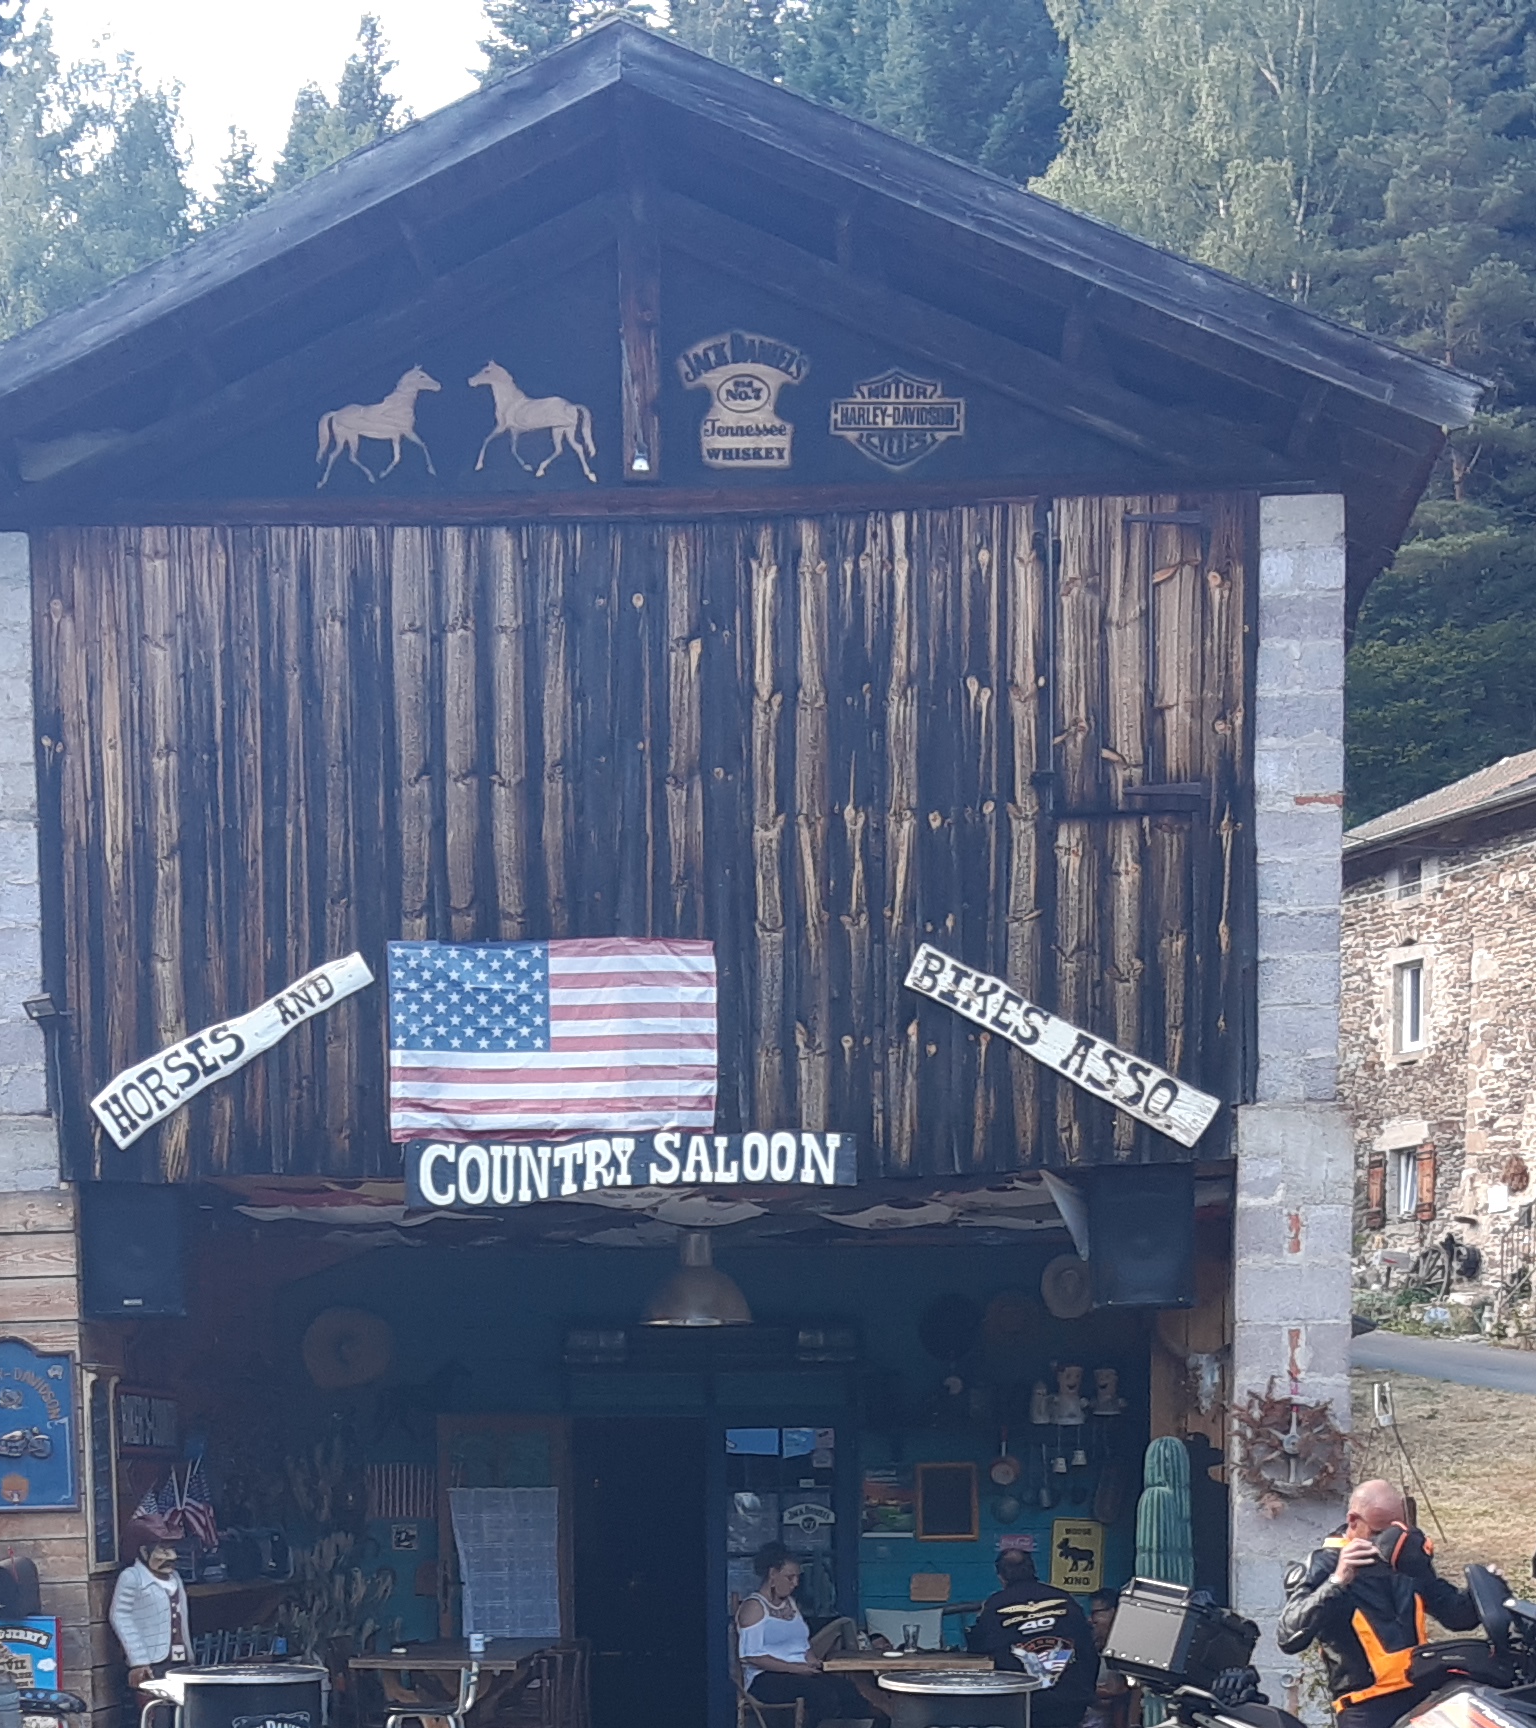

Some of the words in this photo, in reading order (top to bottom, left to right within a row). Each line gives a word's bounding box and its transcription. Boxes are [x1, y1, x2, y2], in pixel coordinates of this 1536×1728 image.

[840, 405, 955, 426] HARLEY-DAVIDSON
[704, 418, 787, 437] Tennessee
[706, 447, 786, 461] WHISKEY
[914, 950, 1051, 1047] BIKES
[99, 1024, 246, 1139] HORSES
[273, 973, 335, 1027] AND
[418, 1136, 636, 1206] COUNTRY
[649, 1131, 842, 1185] SALOON
[1017, 1617, 1056, 1631] 40
